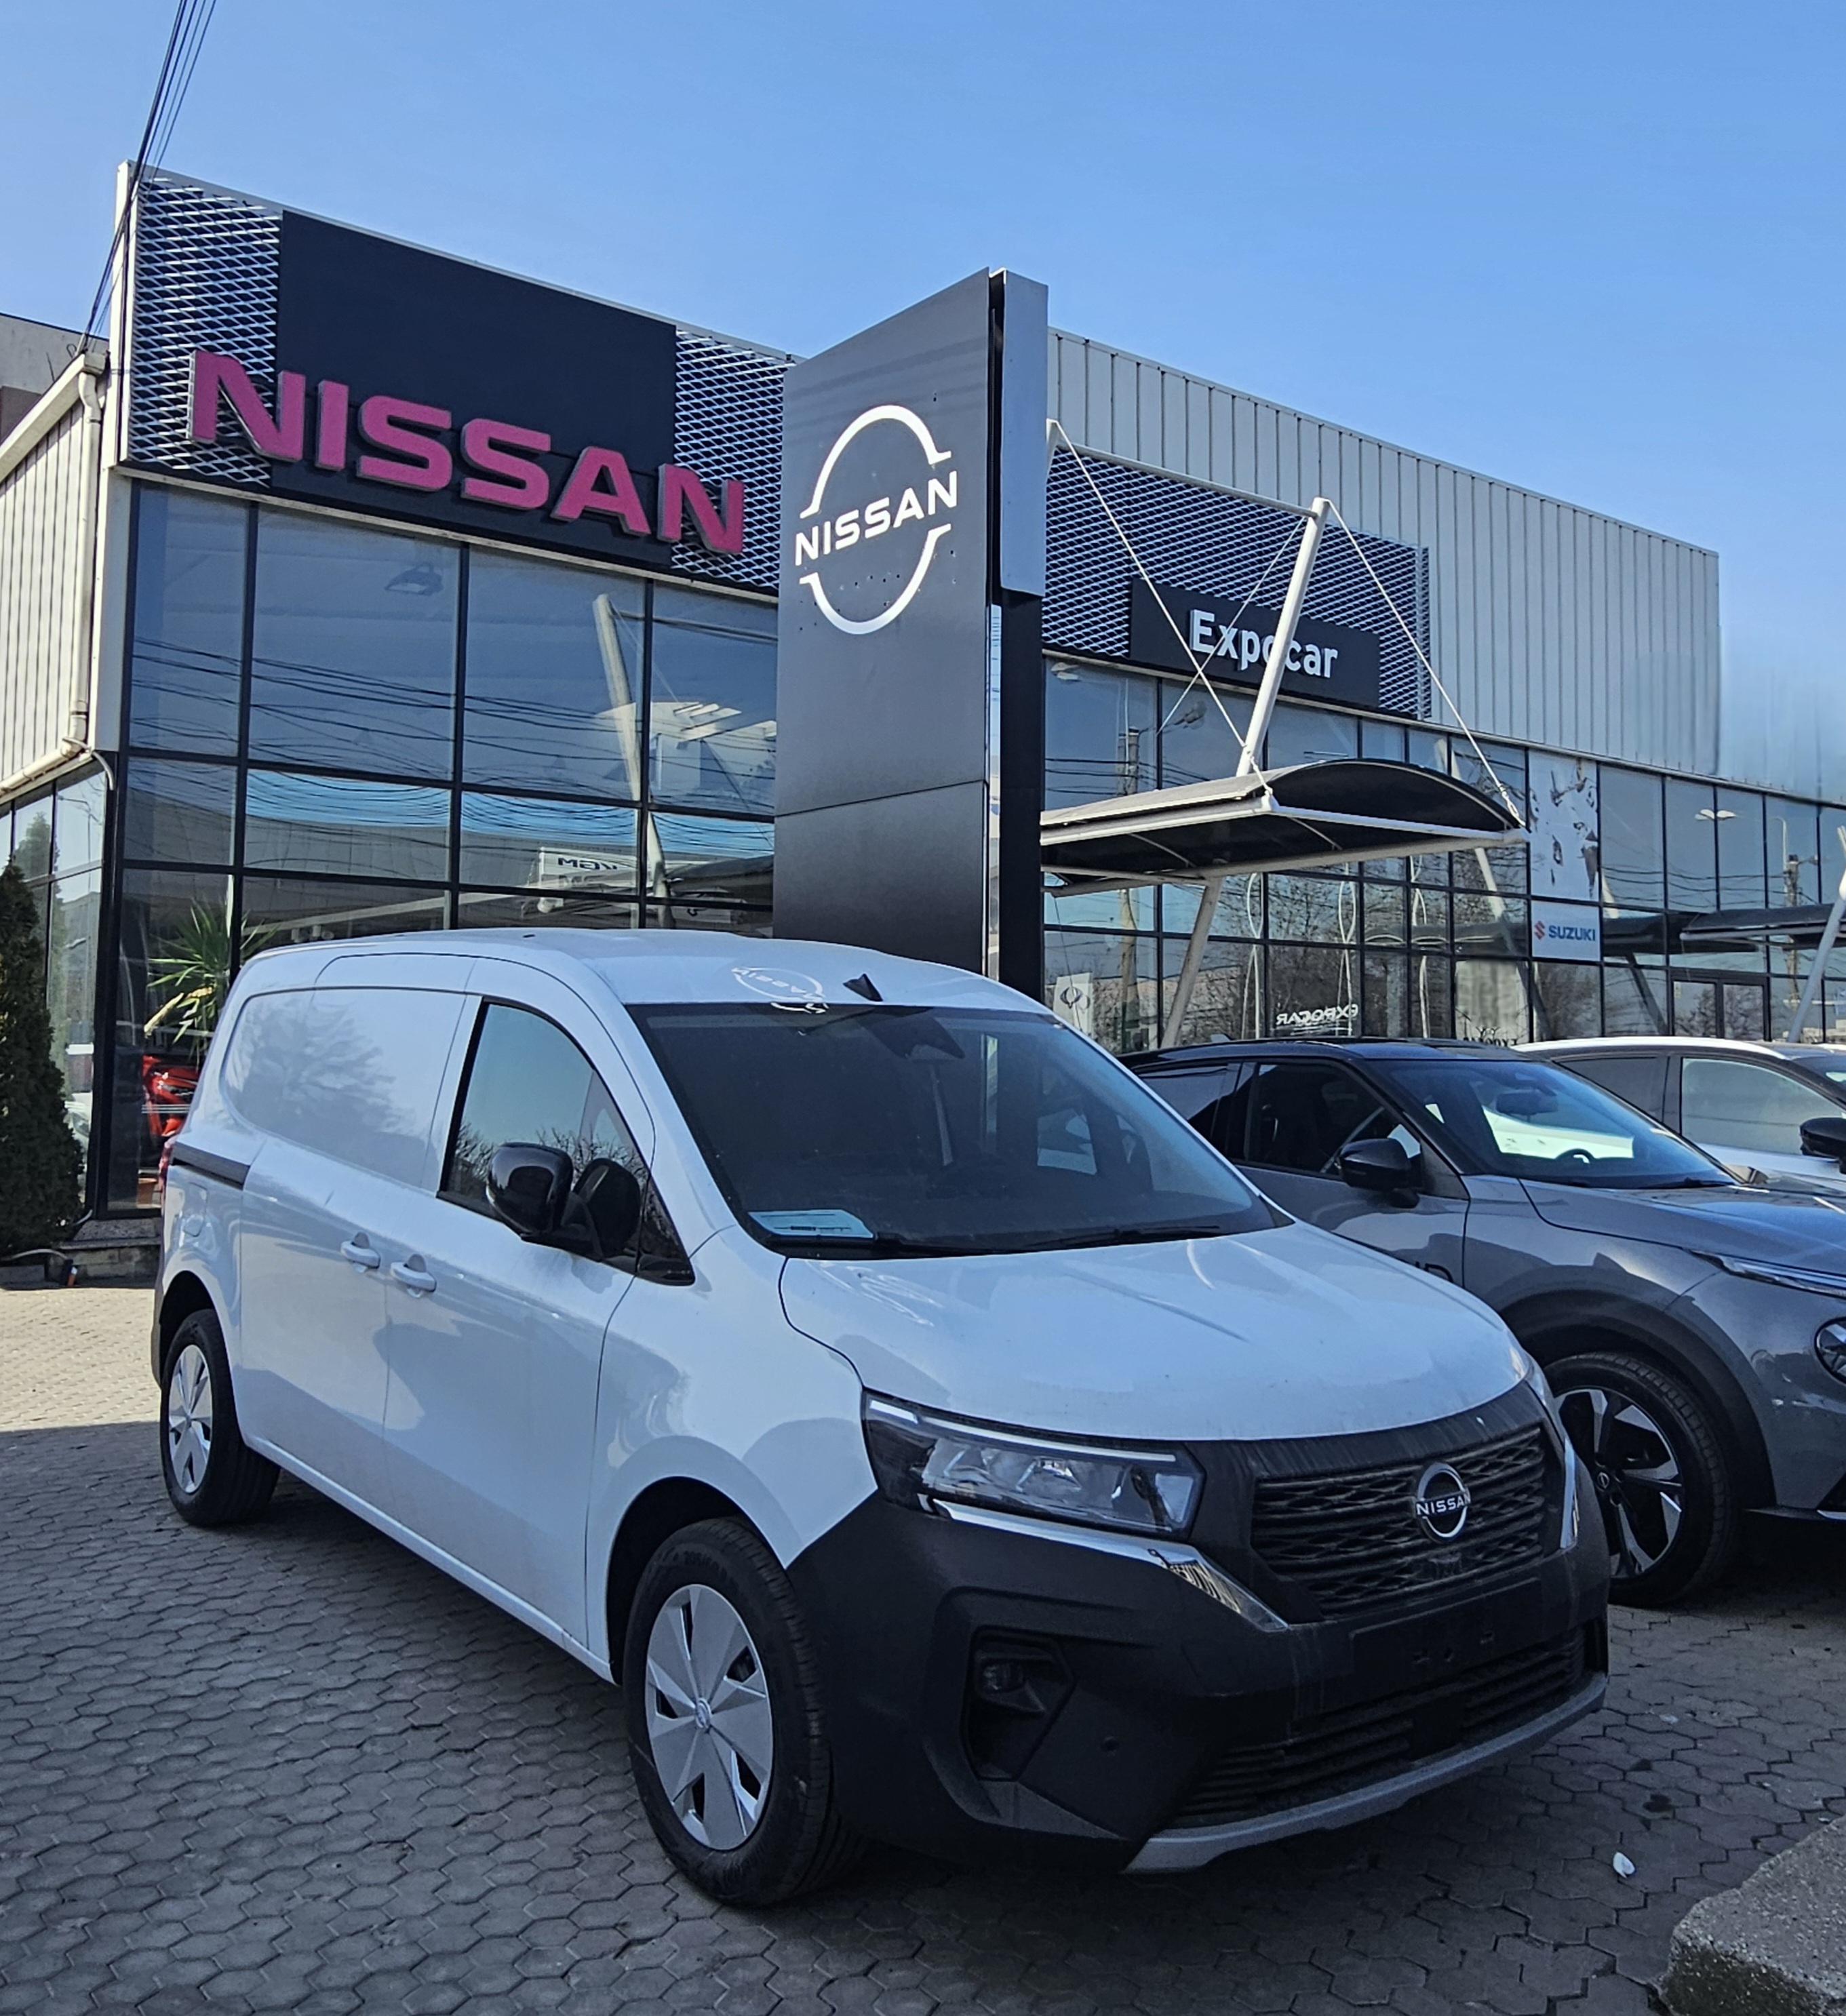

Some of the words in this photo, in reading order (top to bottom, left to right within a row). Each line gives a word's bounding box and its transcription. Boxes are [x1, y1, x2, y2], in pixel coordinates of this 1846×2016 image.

[189, 350, 744, 553] NISSAN
[795, 470, 958, 566] NISSAN
[1548, 925, 1596, 941] SUZUKI
[1416, 1486, 1471, 1516] NISSAN
